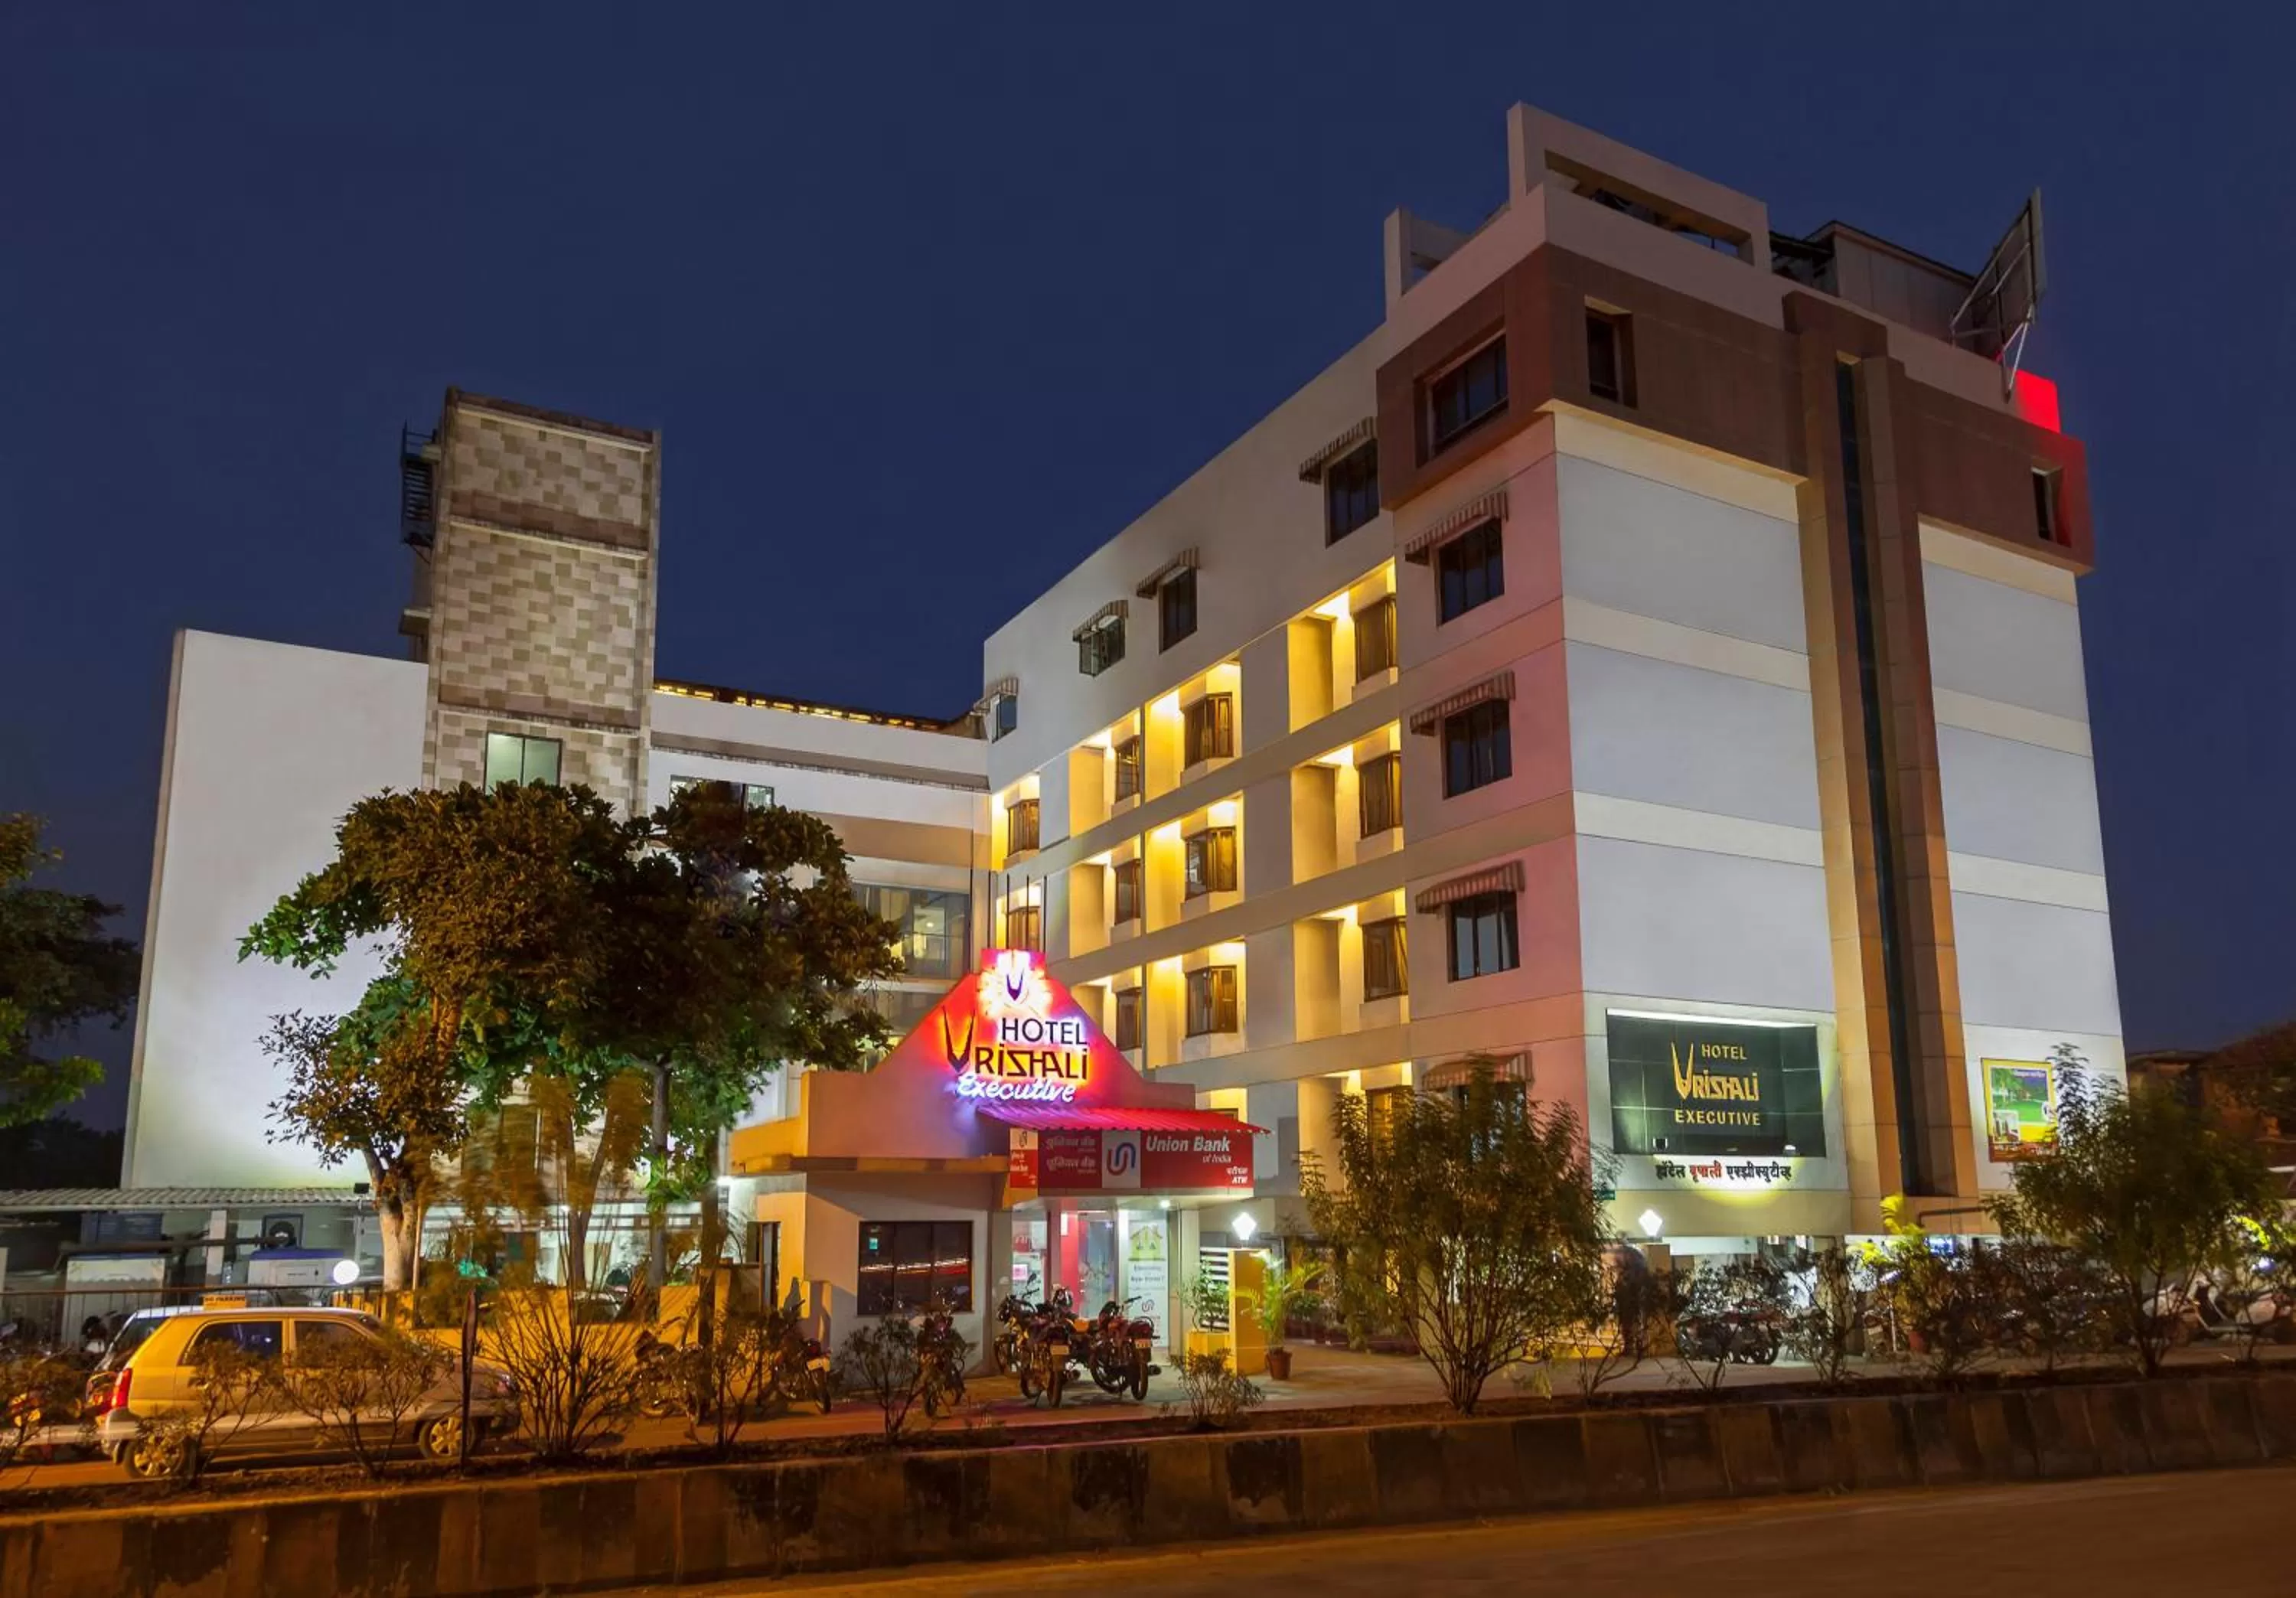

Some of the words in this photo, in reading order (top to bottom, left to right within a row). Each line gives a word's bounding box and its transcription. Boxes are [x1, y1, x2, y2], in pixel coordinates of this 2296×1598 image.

[1001, 1017, 1088, 1045] HOTEL
[1701, 1043, 1748, 1060] HOTEL
[957, 1071, 1077, 1102] Executive
[1675, 1109, 1761, 1126] EXECUTIVE
[1146, 1136, 1189, 1151] Union
[1193, 1136, 1231, 1151] Bank
[1212, 1154, 1232, 1163] India
